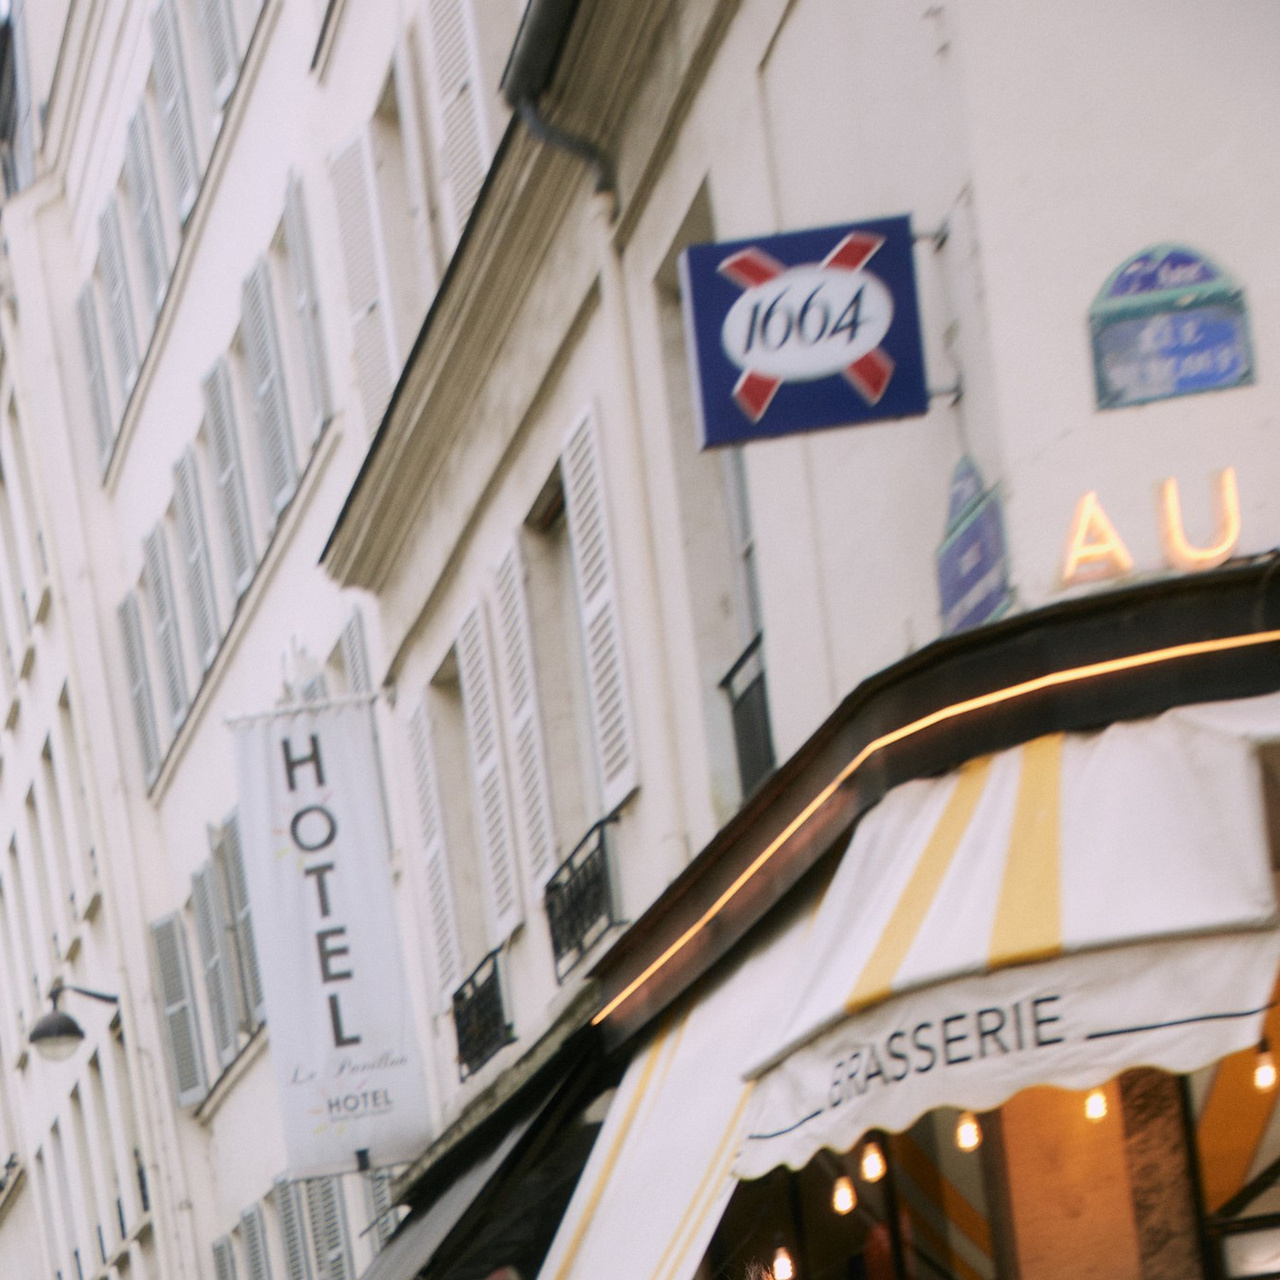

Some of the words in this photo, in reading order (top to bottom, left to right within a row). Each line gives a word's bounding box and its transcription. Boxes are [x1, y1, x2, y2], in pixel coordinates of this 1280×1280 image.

[741, 283, 874, 356] 1664
[1062, 466, 1244, 583] AU
[280, 733, 362, 1049] HOTEL
[327, 1089, 393, 1114] HOTEL
[827, 994, 1067, 1109] BRASSERIE
